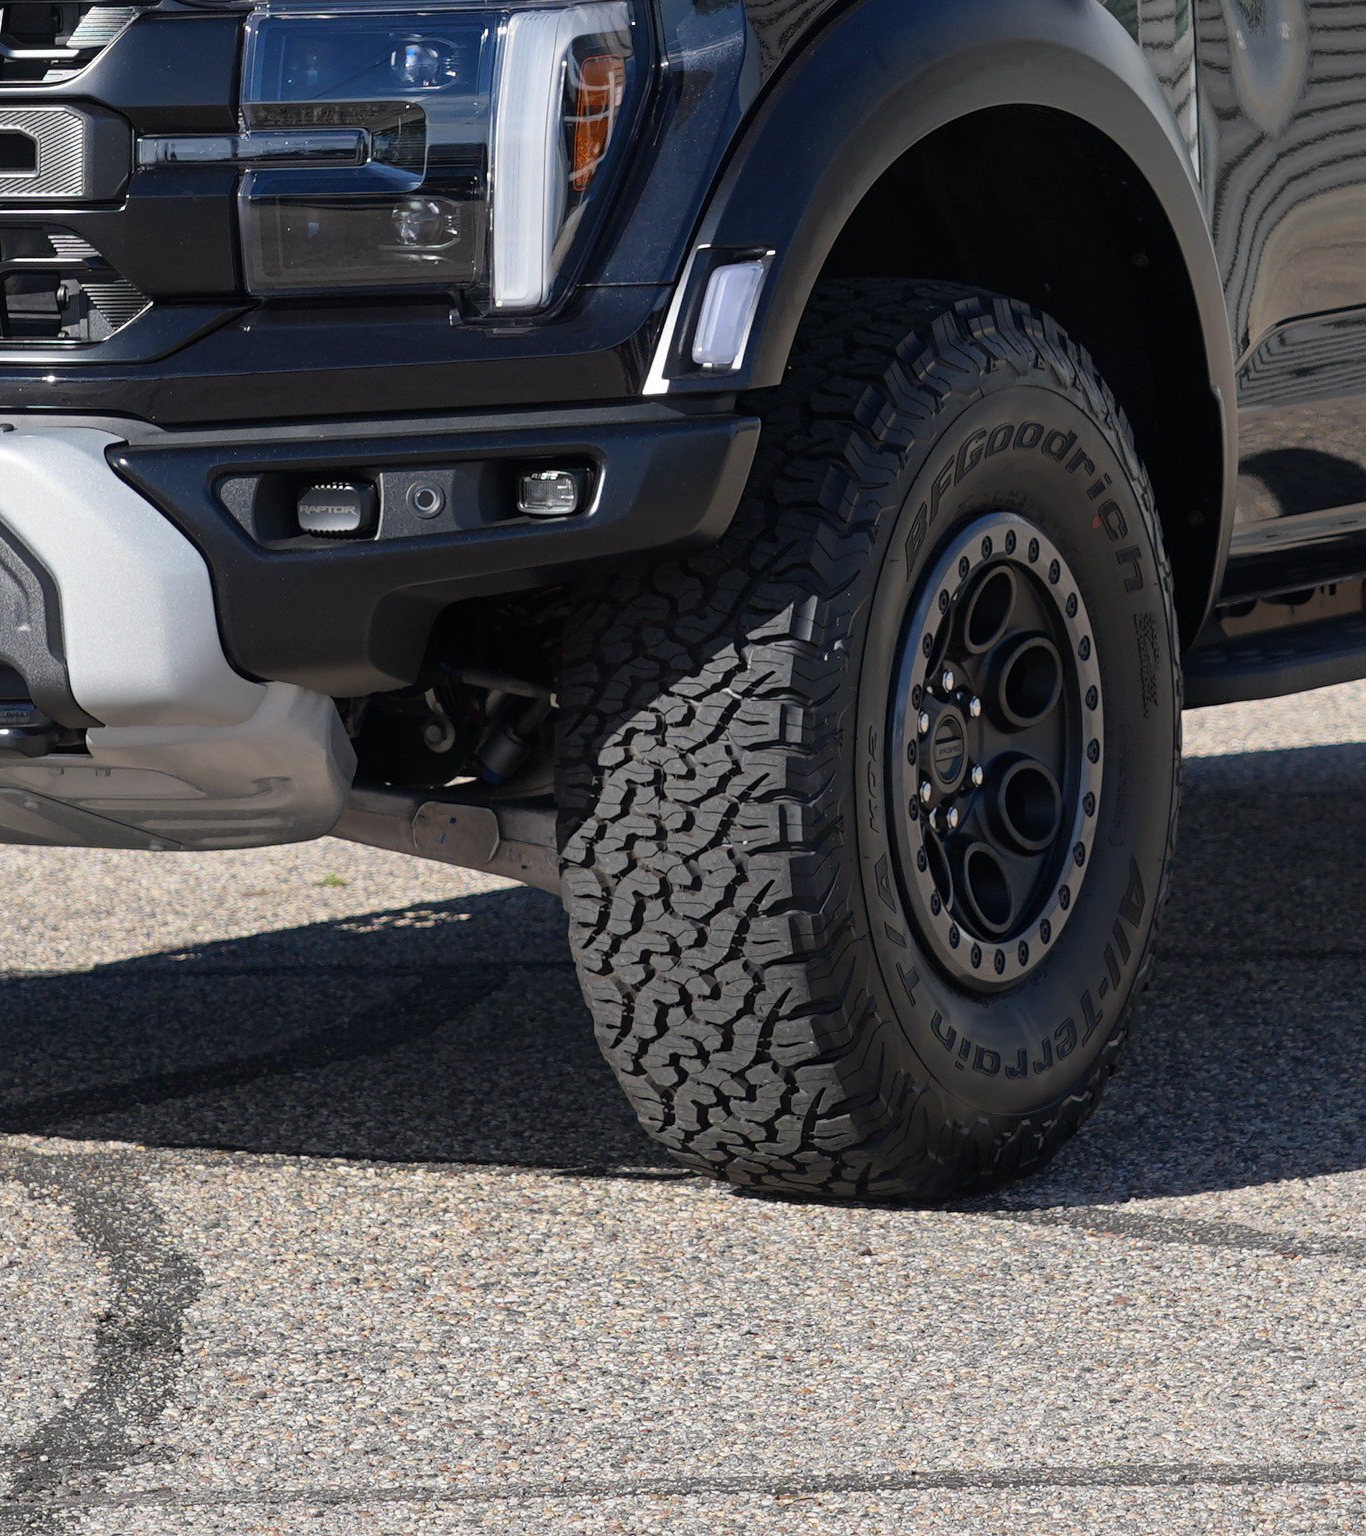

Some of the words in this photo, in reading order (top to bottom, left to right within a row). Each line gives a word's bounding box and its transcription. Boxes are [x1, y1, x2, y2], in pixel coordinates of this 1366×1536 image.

[299, 505, 358, 516] RAPTOR
[905, 420, 1144, 594] BFGoodrich
[931, 853, 1146, 1079] All-Terrain
